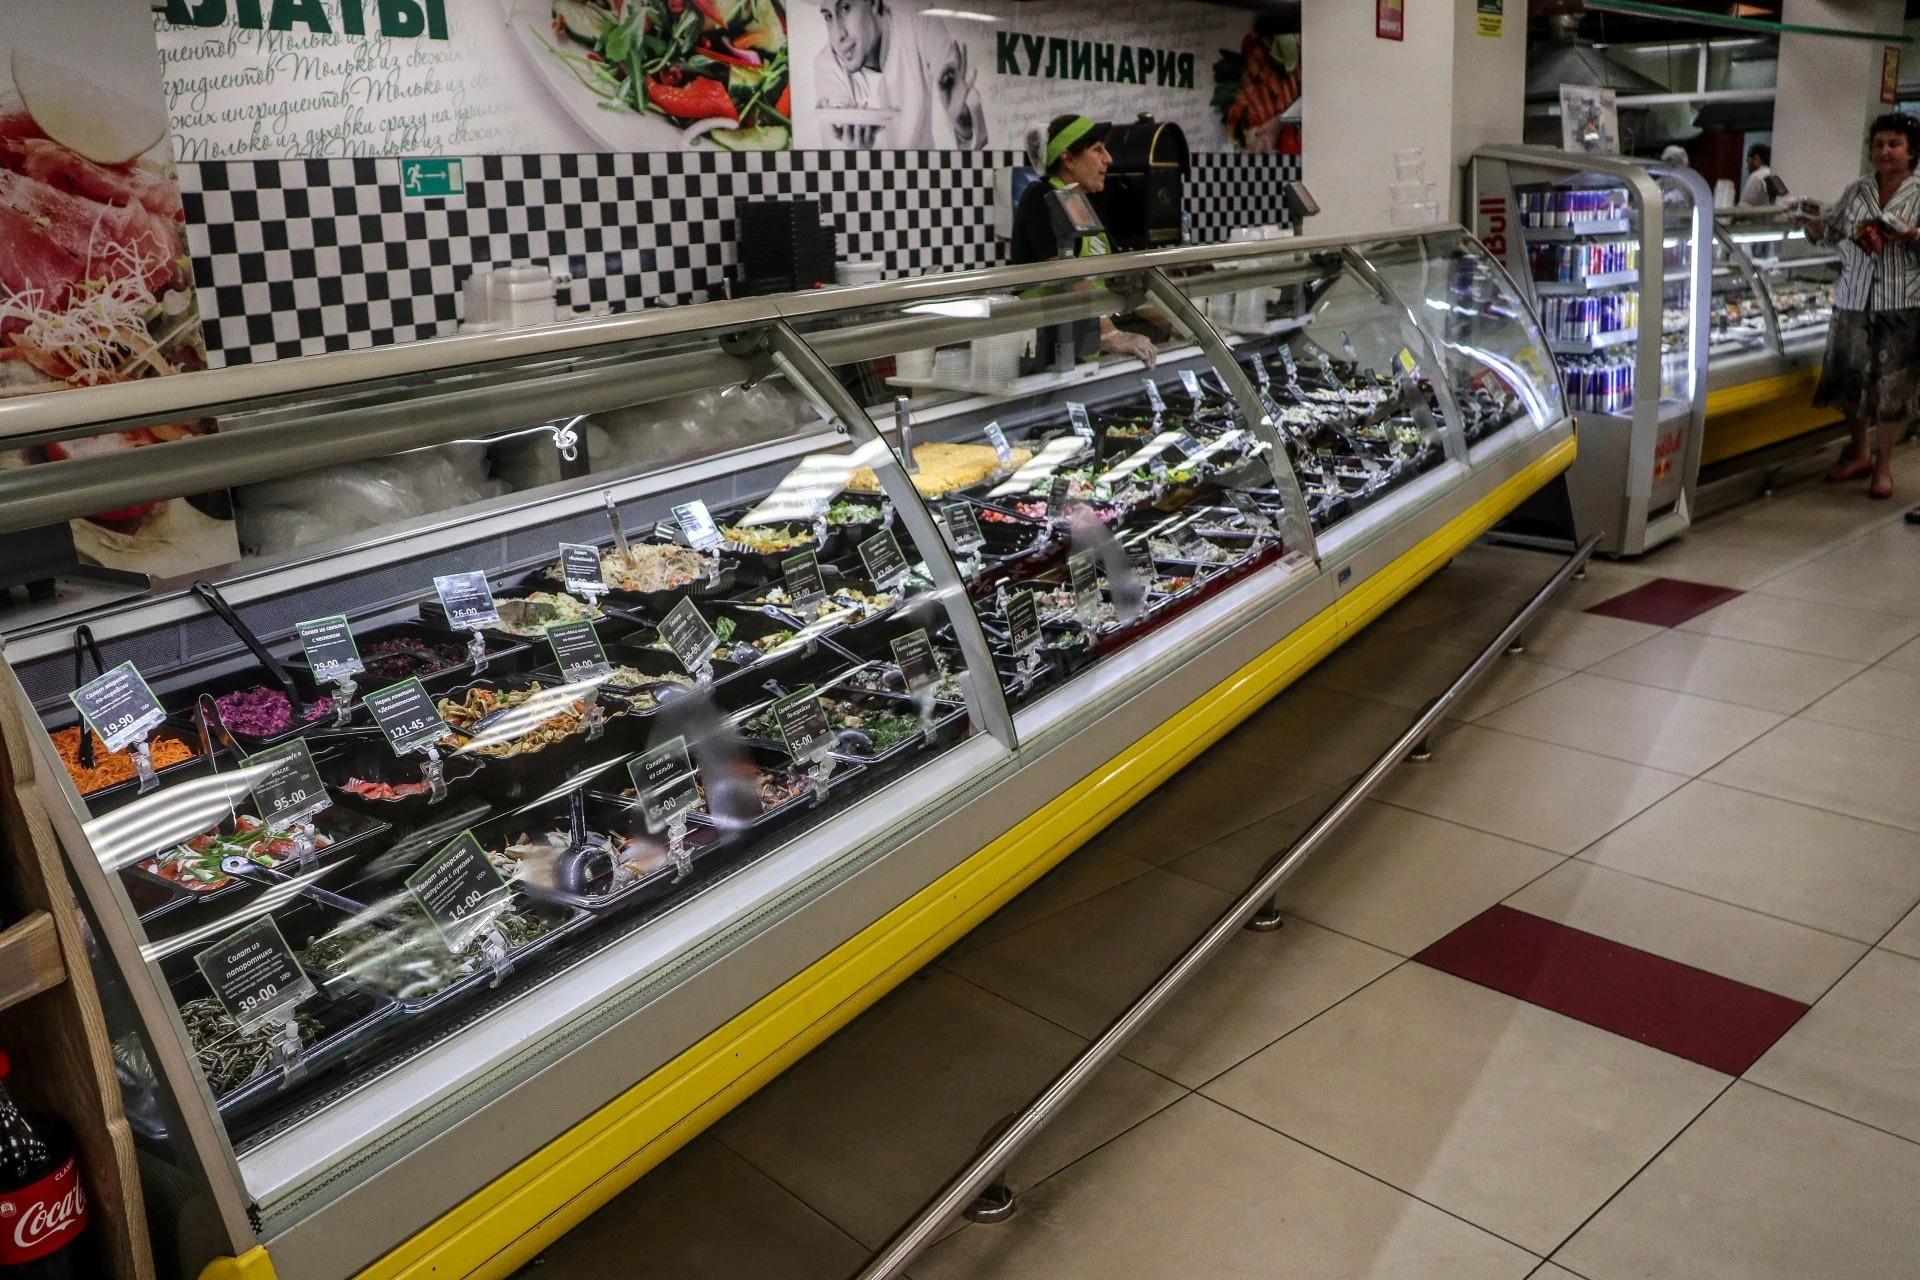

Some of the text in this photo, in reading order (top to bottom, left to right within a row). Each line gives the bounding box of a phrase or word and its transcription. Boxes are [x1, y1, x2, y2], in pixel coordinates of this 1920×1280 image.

[276, 46, 374, 82] Только
[996, 31, 1195, 89] КУЛИНАРИЯ
[350, 67, 442, 104] Только
[171, 120, 272, 161] Только
[313, 659, 339, 672] 29-00
[85, 685, 106, 700] Салат
[95, 683, 129, 705] по-корейски
[374, 696, 392, 706] Нерка
[103, 713, 134, 737] 19-90
[390, 718, 425, 739] 121-45
[790, 734, 813, 752] 35-00
[645, 757, 664, 771] Салат
[273, 789, 306, 811] 95-00
[416, 848, 467, 893] Салат «Морская
[423, 877, 449, 902] капуста
[452, 854, 475, 877] луком»
[449, 890, 482, 922] 14-00
[226, 947, 274, 979] папоротника
[227, 942, 260, 964] Салат из
[279, 971, 292, 982] 100г
[238, 983, 278, 1014] 39-00
